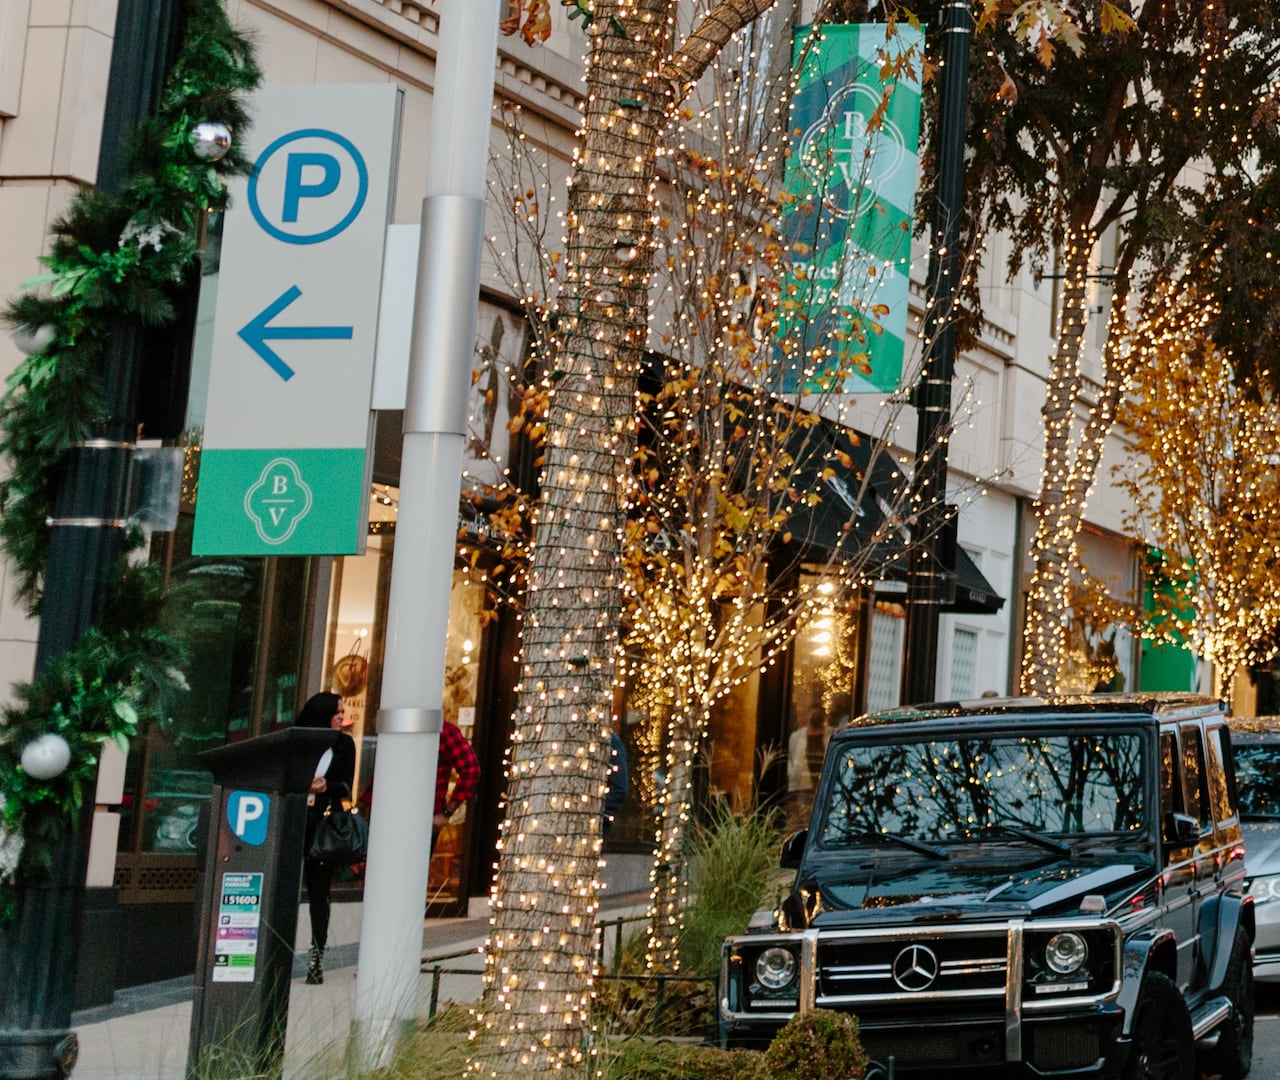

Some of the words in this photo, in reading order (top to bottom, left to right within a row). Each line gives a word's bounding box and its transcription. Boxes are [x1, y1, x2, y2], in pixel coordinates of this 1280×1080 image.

[282, 153, 341, 223] P
[271, 475, 288, 495] B
[268, 507, 288, 527] V
[236, 796, 264, 836] P
[229, 895, 257, 905] 51600
